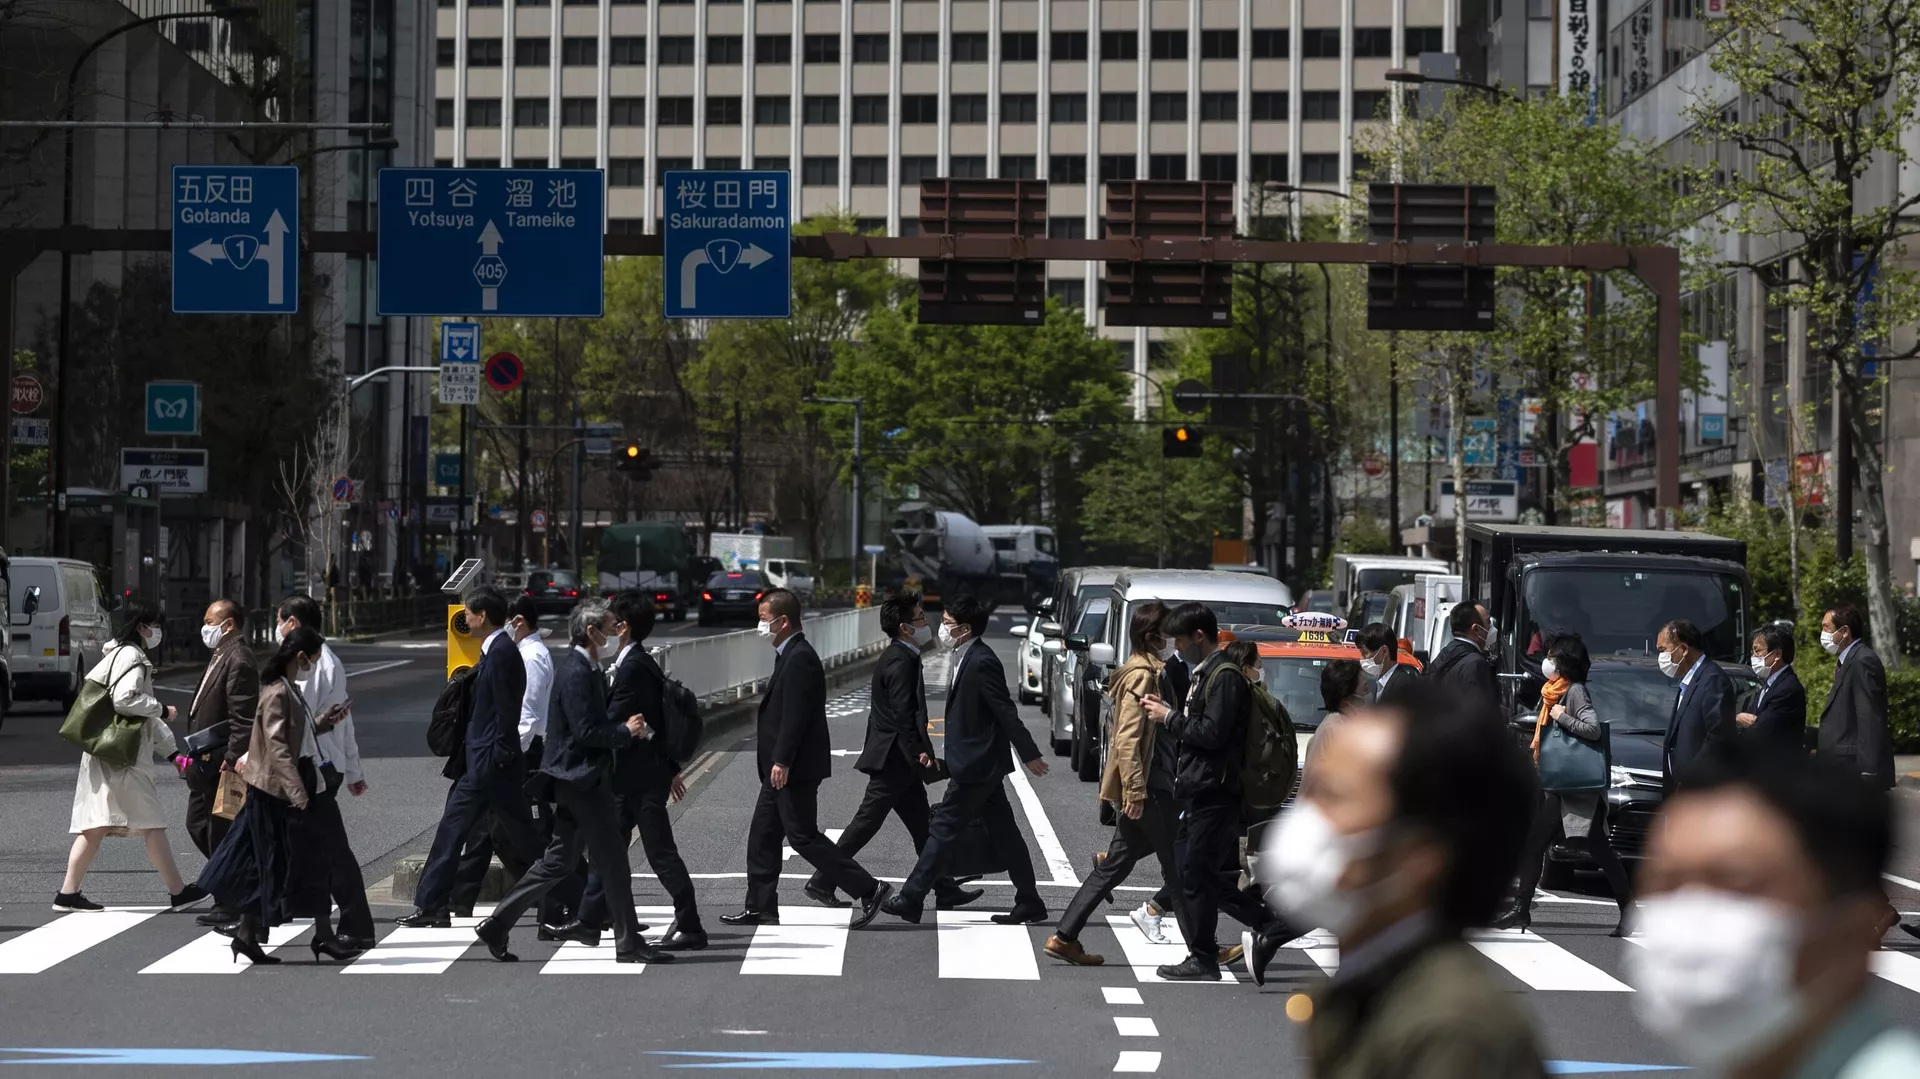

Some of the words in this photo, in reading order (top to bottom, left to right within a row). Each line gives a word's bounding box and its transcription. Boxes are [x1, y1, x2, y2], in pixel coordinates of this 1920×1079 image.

[178, 175, 253, 204] 五反田
[405, 178, 478, 208] 四谷
[505, 178, 577, 208] 溜池
[677, 179, 777, 210] 桜田門
[181, 207, 250, 225] Gotanda
[409, 211, 474, 230] Yotsuya
[506, 211, 576, 228] Tameike
[670, 213, 785, 229] Sakuradamon
[236, 241, 246, 260] 1
[718, 246, 727, 265] 1
[477, 262, 504, 280] 405
[140, 467, 188, 481] 虎ノ門駅
[1468, 498, 1500, 508] ノ門駅
[1299, 617, 1332, 628] チェッカー無線
[1304, 631, 1325, 640] 1638
